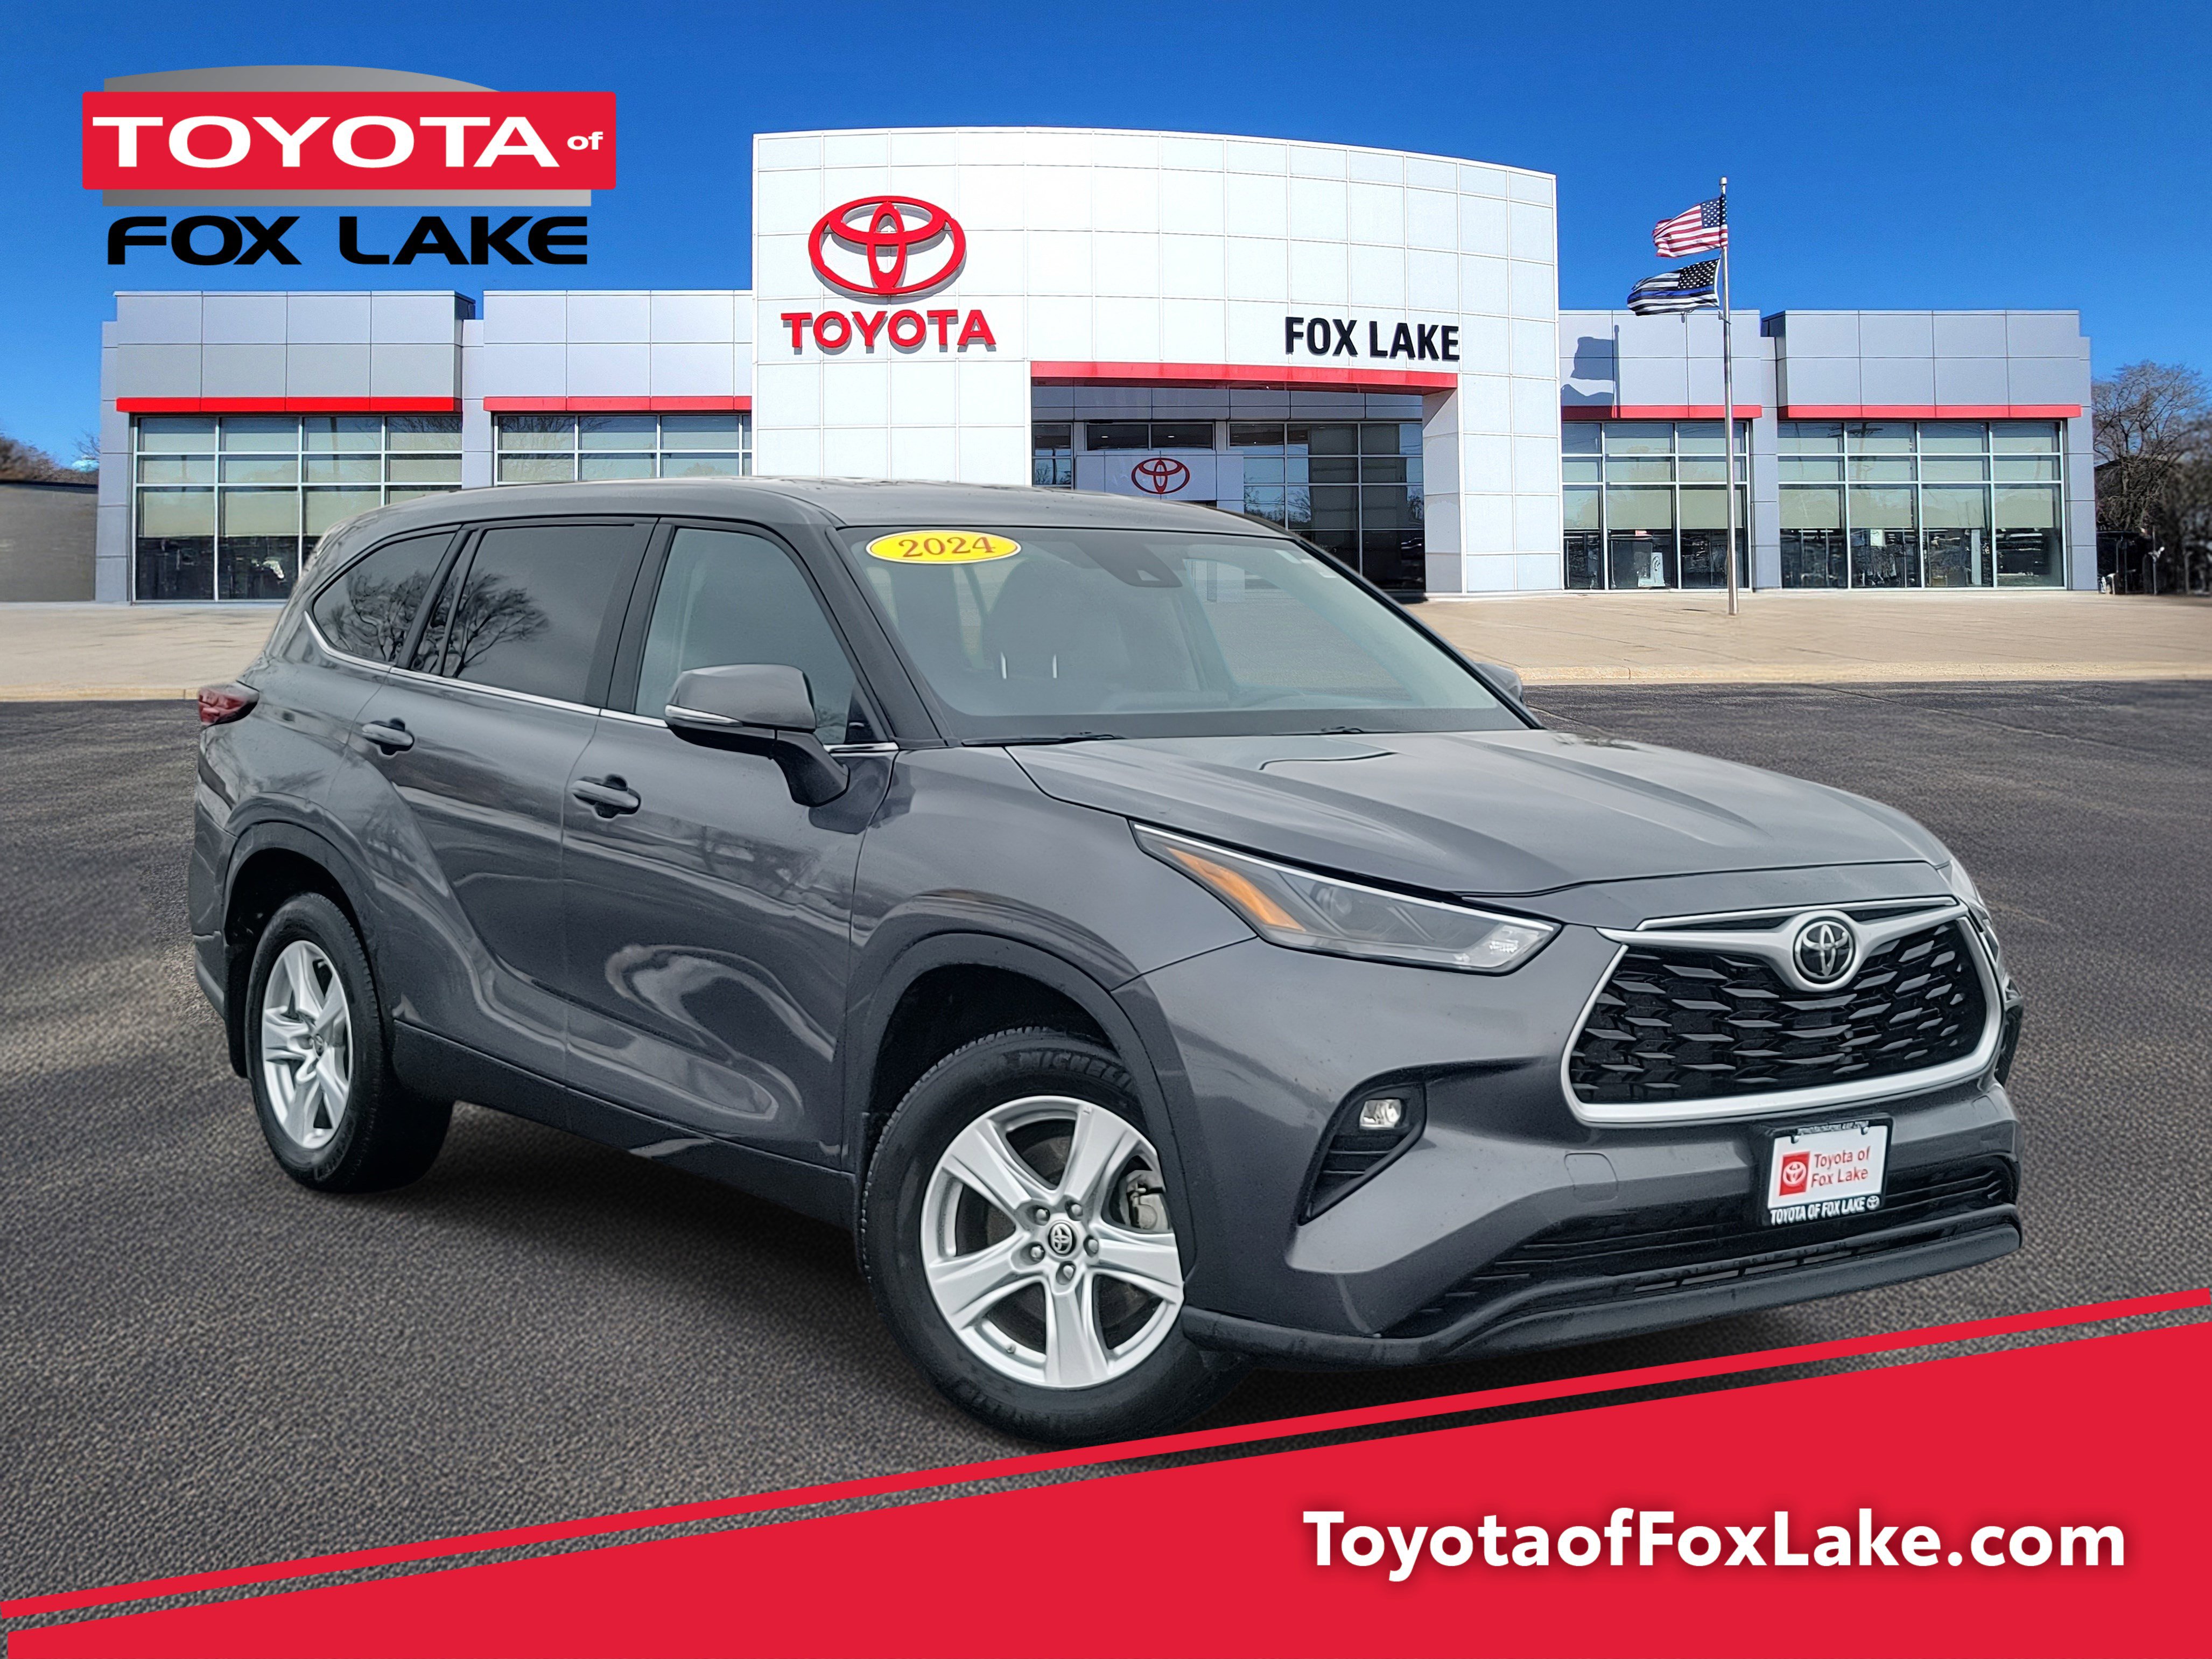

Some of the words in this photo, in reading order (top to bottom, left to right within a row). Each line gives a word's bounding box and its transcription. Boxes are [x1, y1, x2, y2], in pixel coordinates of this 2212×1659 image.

[780, 309, 996, 349] TOYOTA
[1285, 317, 1358, 358] FOX
[1369, 320, 1460, 361] LAKE
[898, 536, 996, 557] 2024
[1814, 1150, 1853, 1170] Toyota
[1857, 1145, 1871, 1161] of
[1810, 1173, 1834, 1188] Fox
[1837, 1166, 1868, 1182] Lake
[1770, 1206, 1807, 1226] TOYOTA
[1807, 1203, 1821, 1220] OF
[1821, 1200, 1841, 1218] FOX
[1841, 1196, 1866, 1215] LAKE
